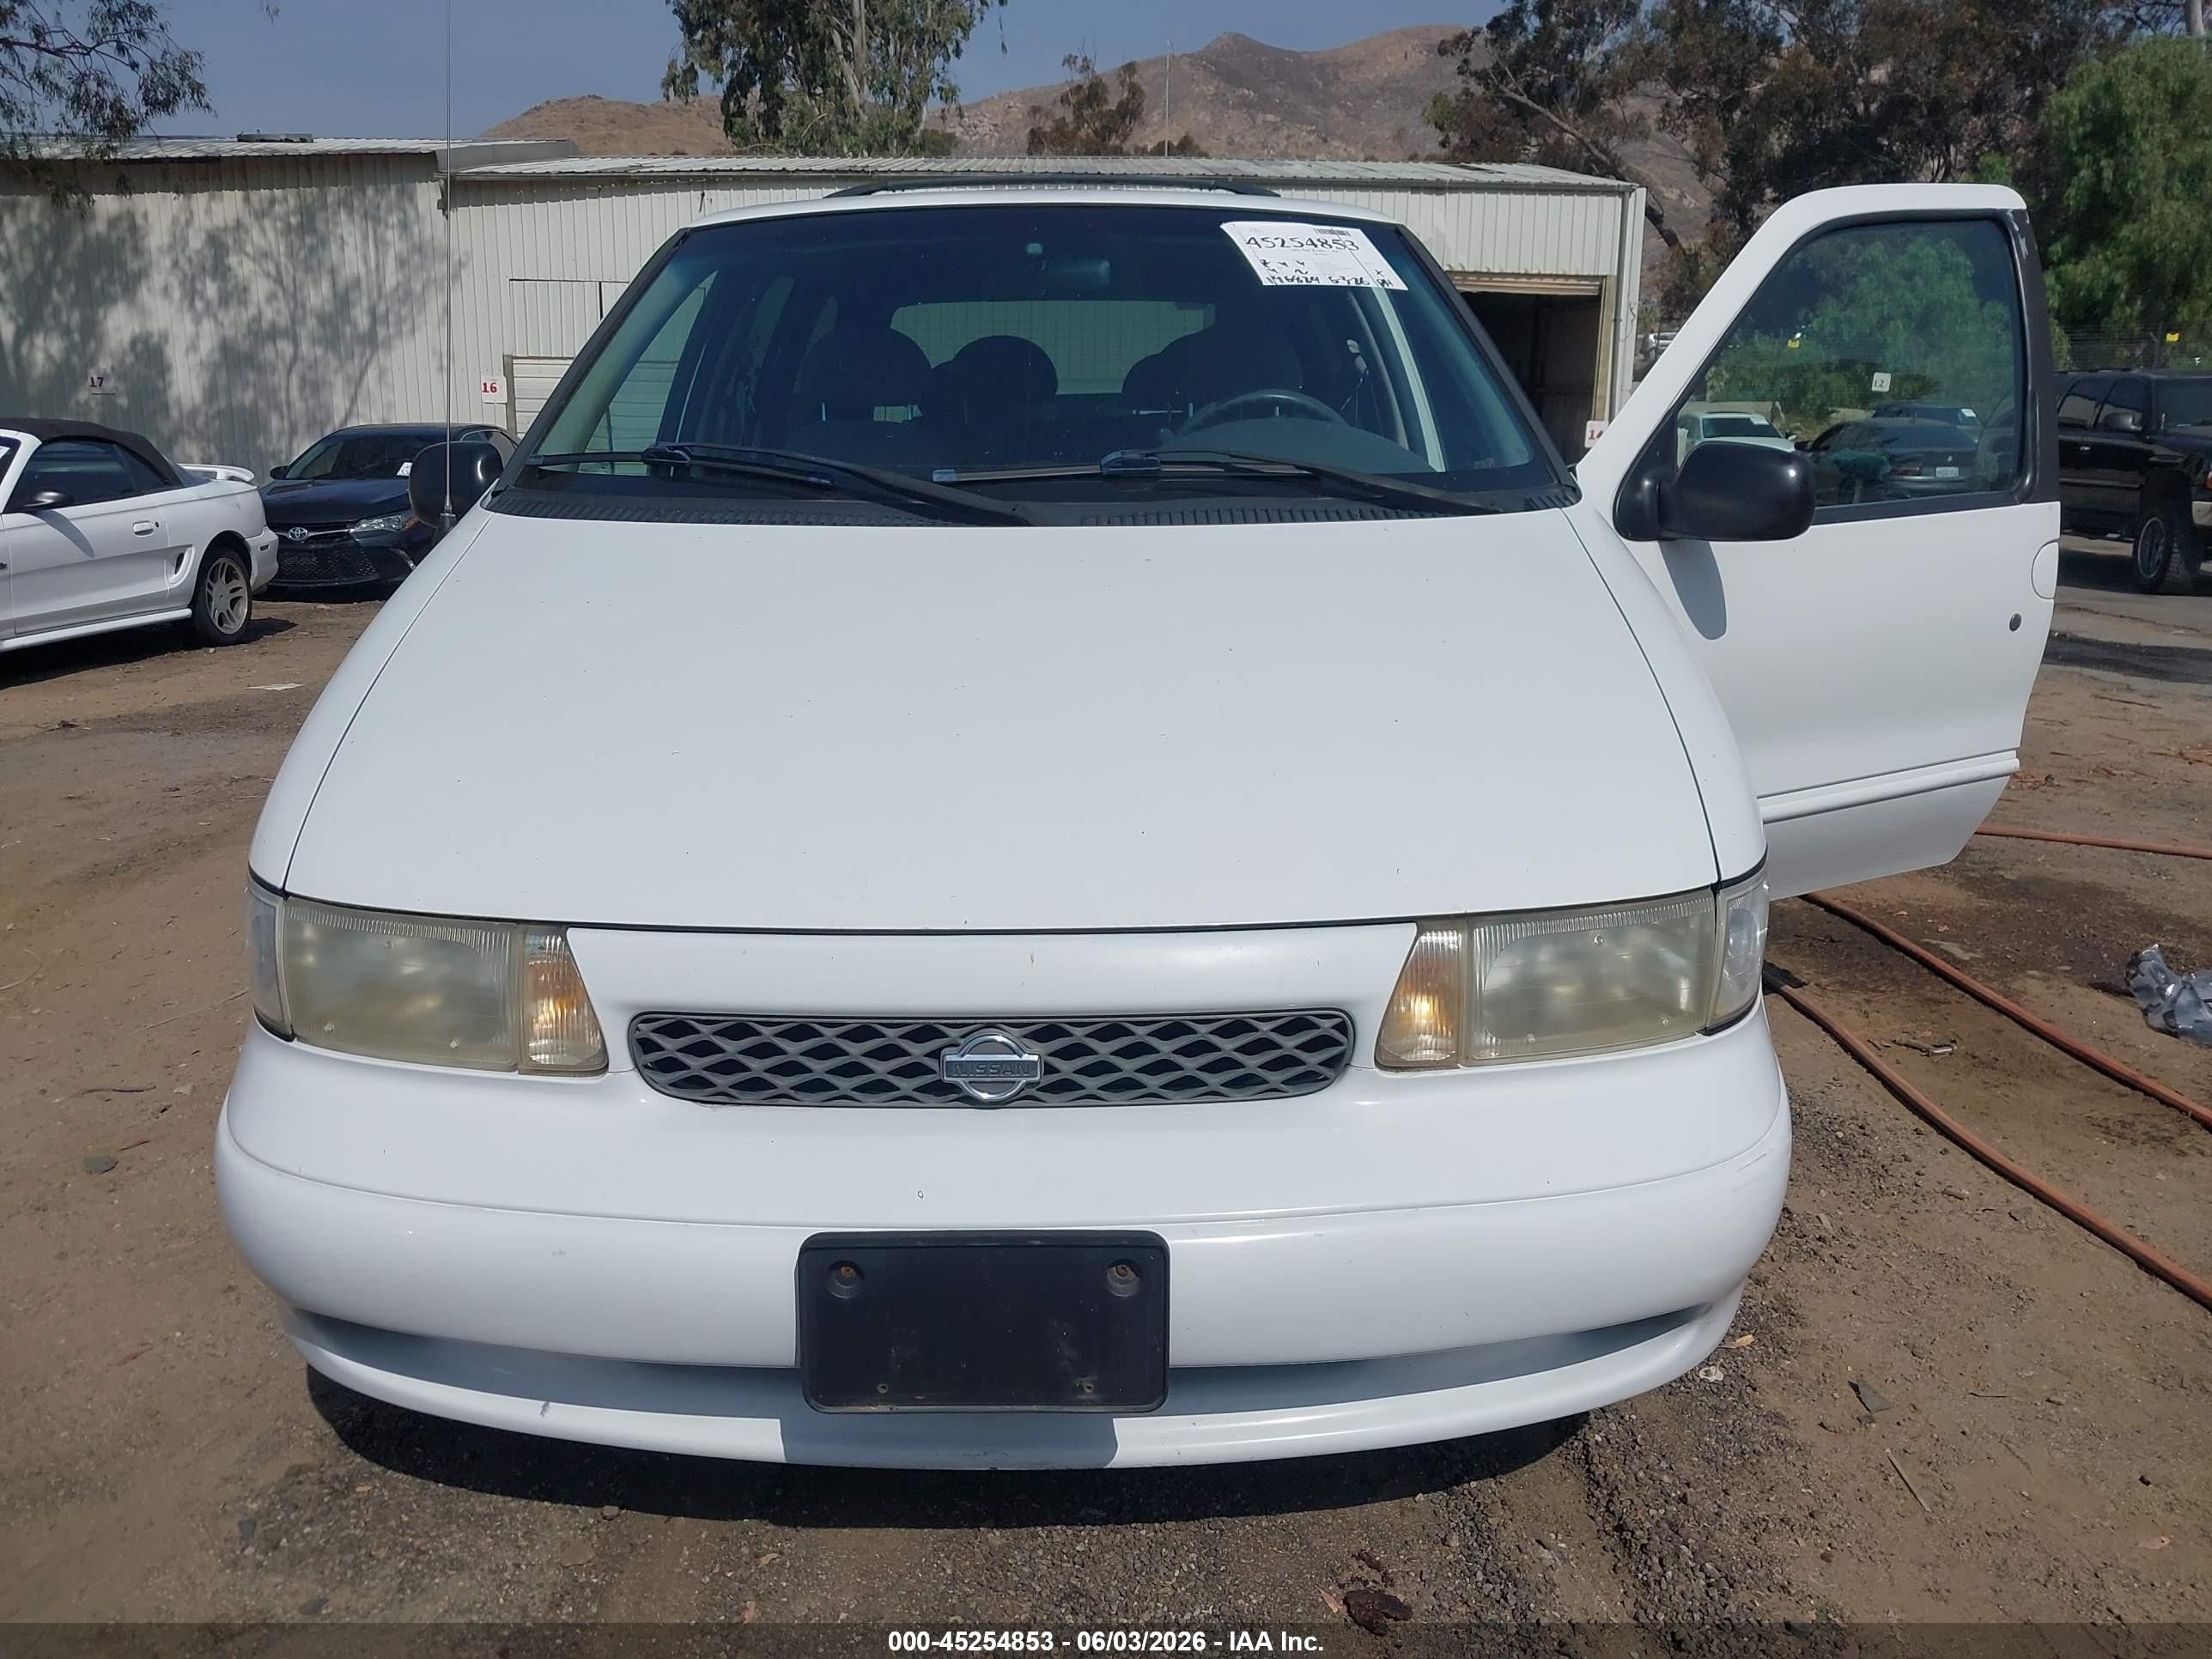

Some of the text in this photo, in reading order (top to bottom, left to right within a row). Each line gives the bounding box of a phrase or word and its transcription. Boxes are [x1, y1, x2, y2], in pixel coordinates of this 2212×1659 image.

[1245, 236, 1360, 251] 45254853
[88, 376, 104, 388] 17
[482, 382, 497, 393] 16
[1874, 379, 1885, 387] 12
[950, 1062, 1030, 1077] NISSAN
